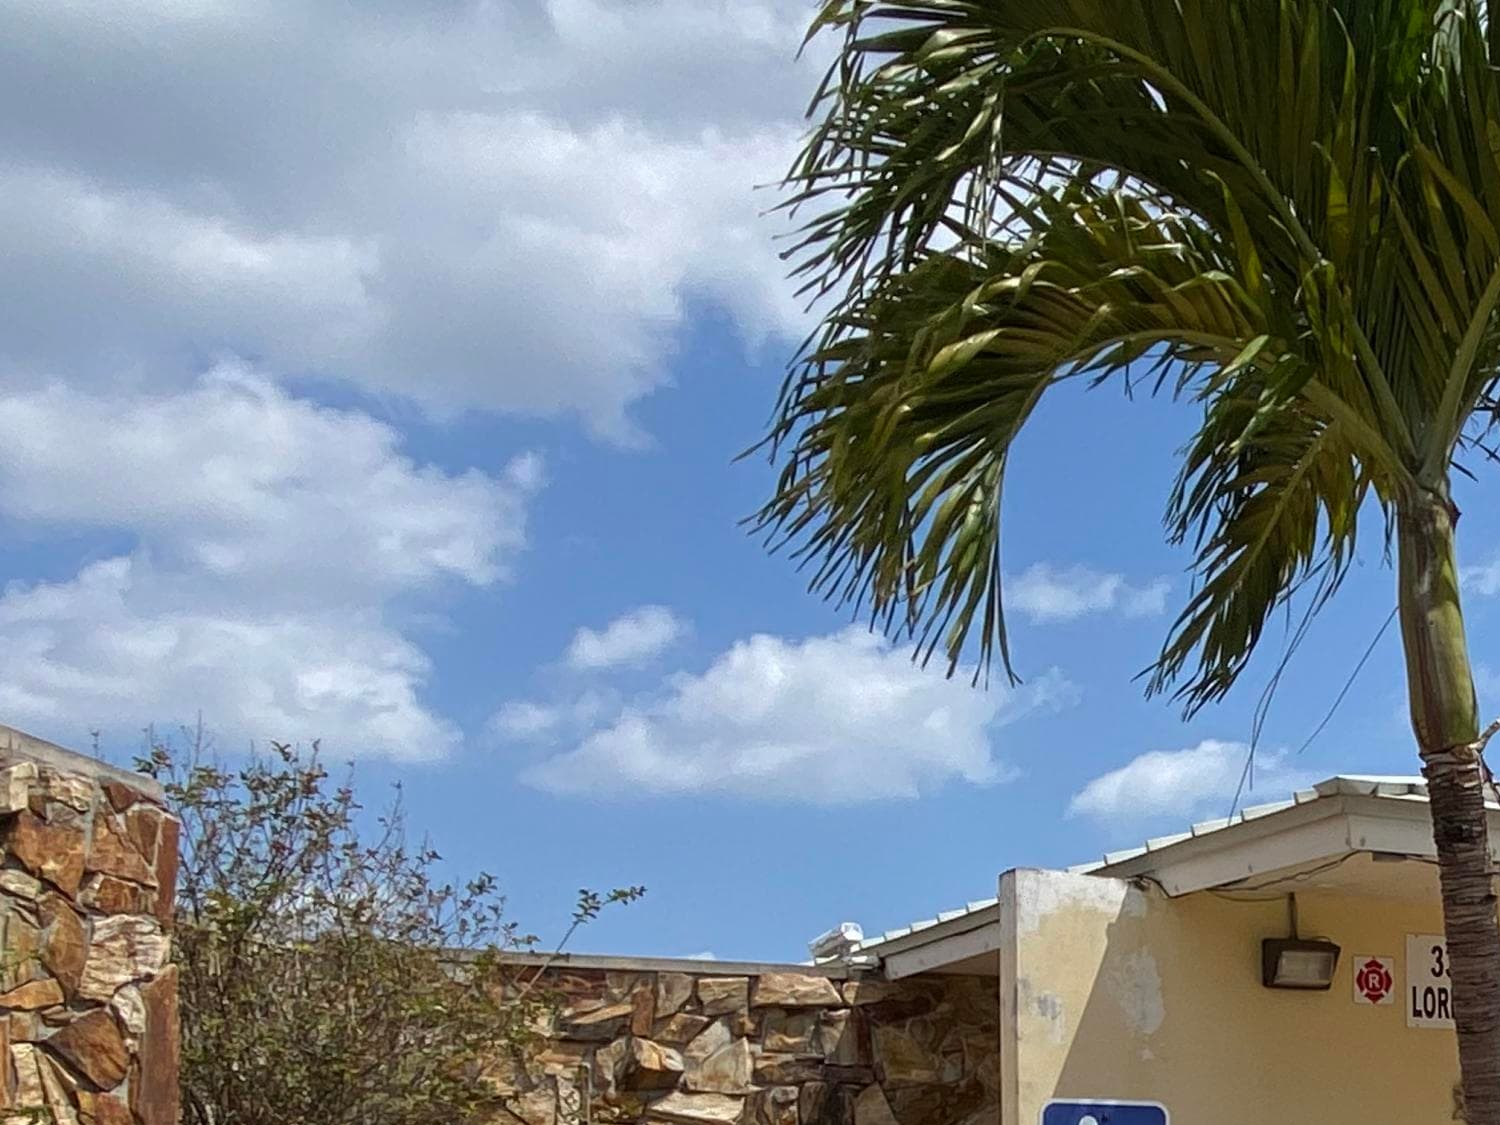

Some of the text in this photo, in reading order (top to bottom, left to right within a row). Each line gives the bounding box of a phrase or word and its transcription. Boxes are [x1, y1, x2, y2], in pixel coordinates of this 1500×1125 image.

[1431, 945, 1452, 977] 3
[1368, 974, 1380, 989] R
[1412, 986, 1455, 1019] LOR
